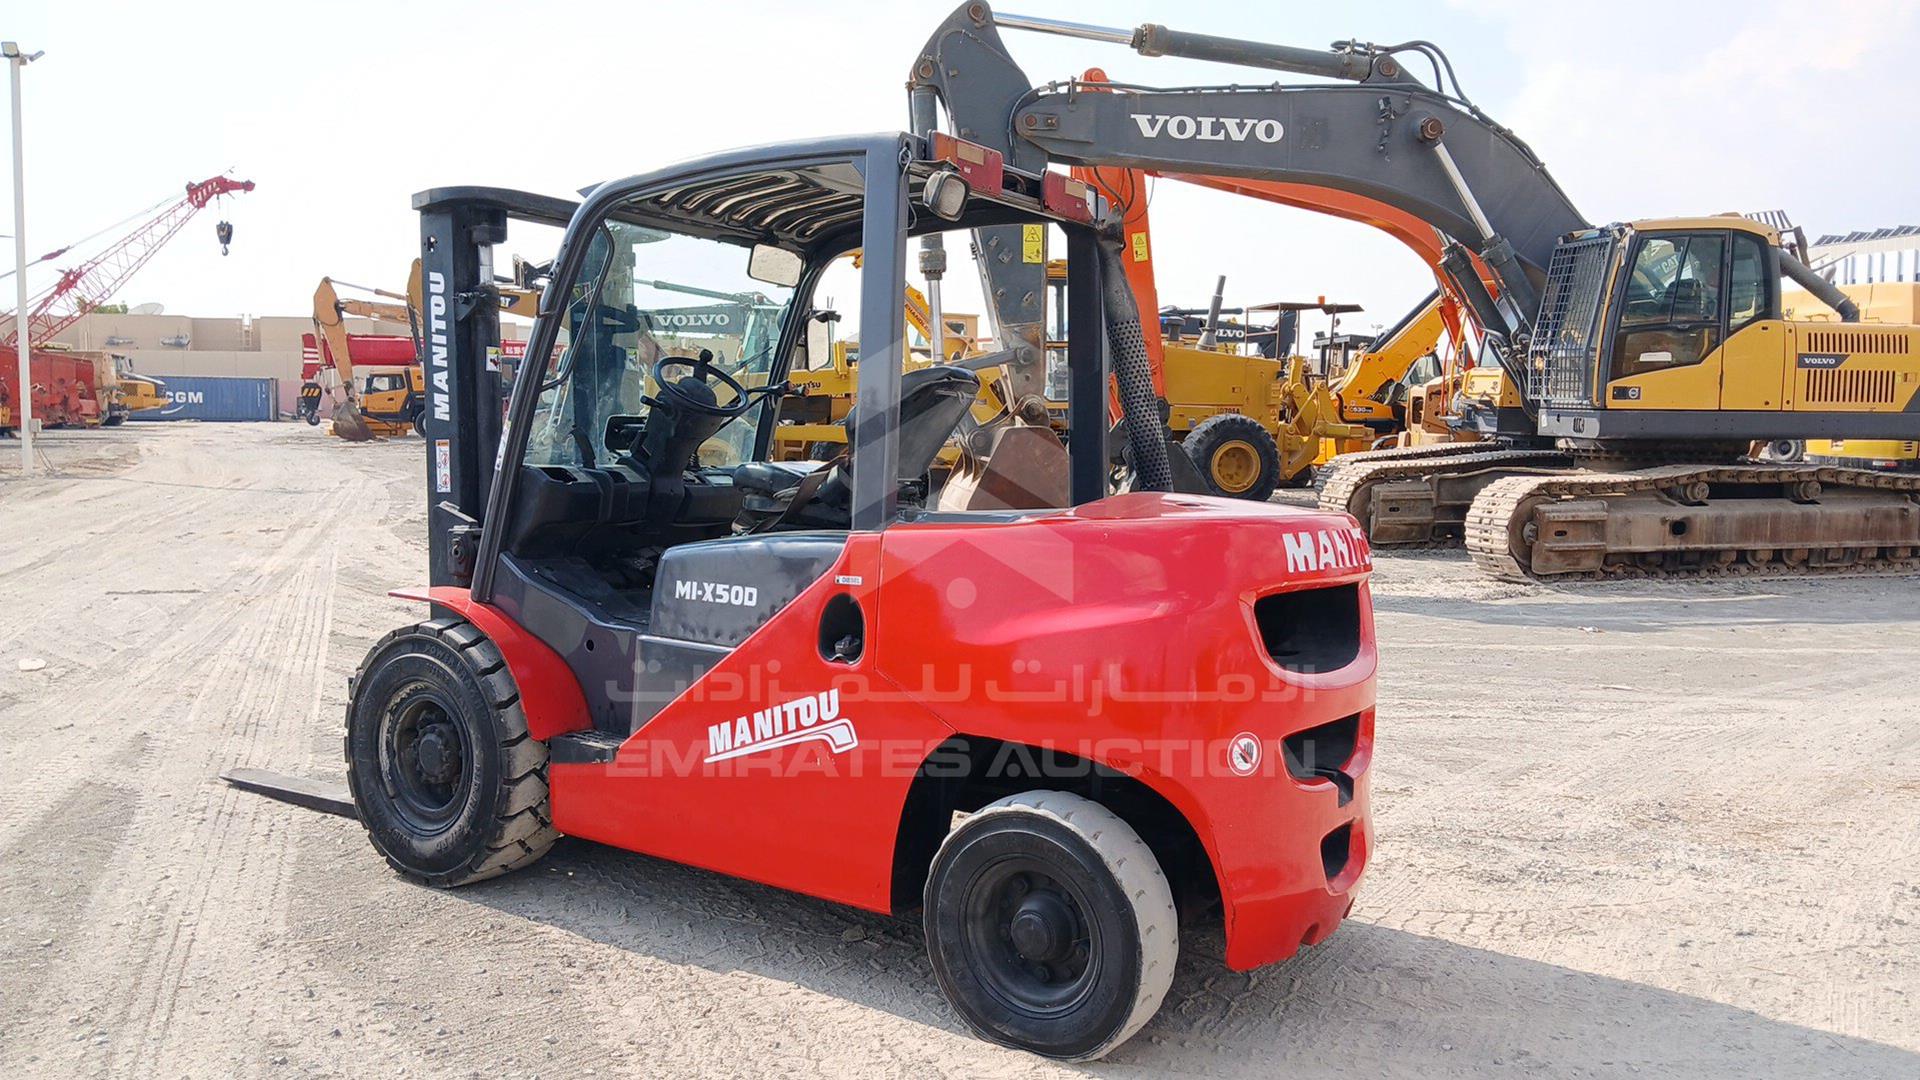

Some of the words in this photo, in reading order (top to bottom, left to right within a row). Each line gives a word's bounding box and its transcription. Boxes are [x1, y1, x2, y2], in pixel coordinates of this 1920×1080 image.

[1130, 114, 1284, 143] VOLVO
[655, 313, 730, 327] VOLVO
[429, 271, 450, 421] MANITOU
[1804, 357, 1836, 365] VOLVO
[708, 687, 840, 756] MANITOU
